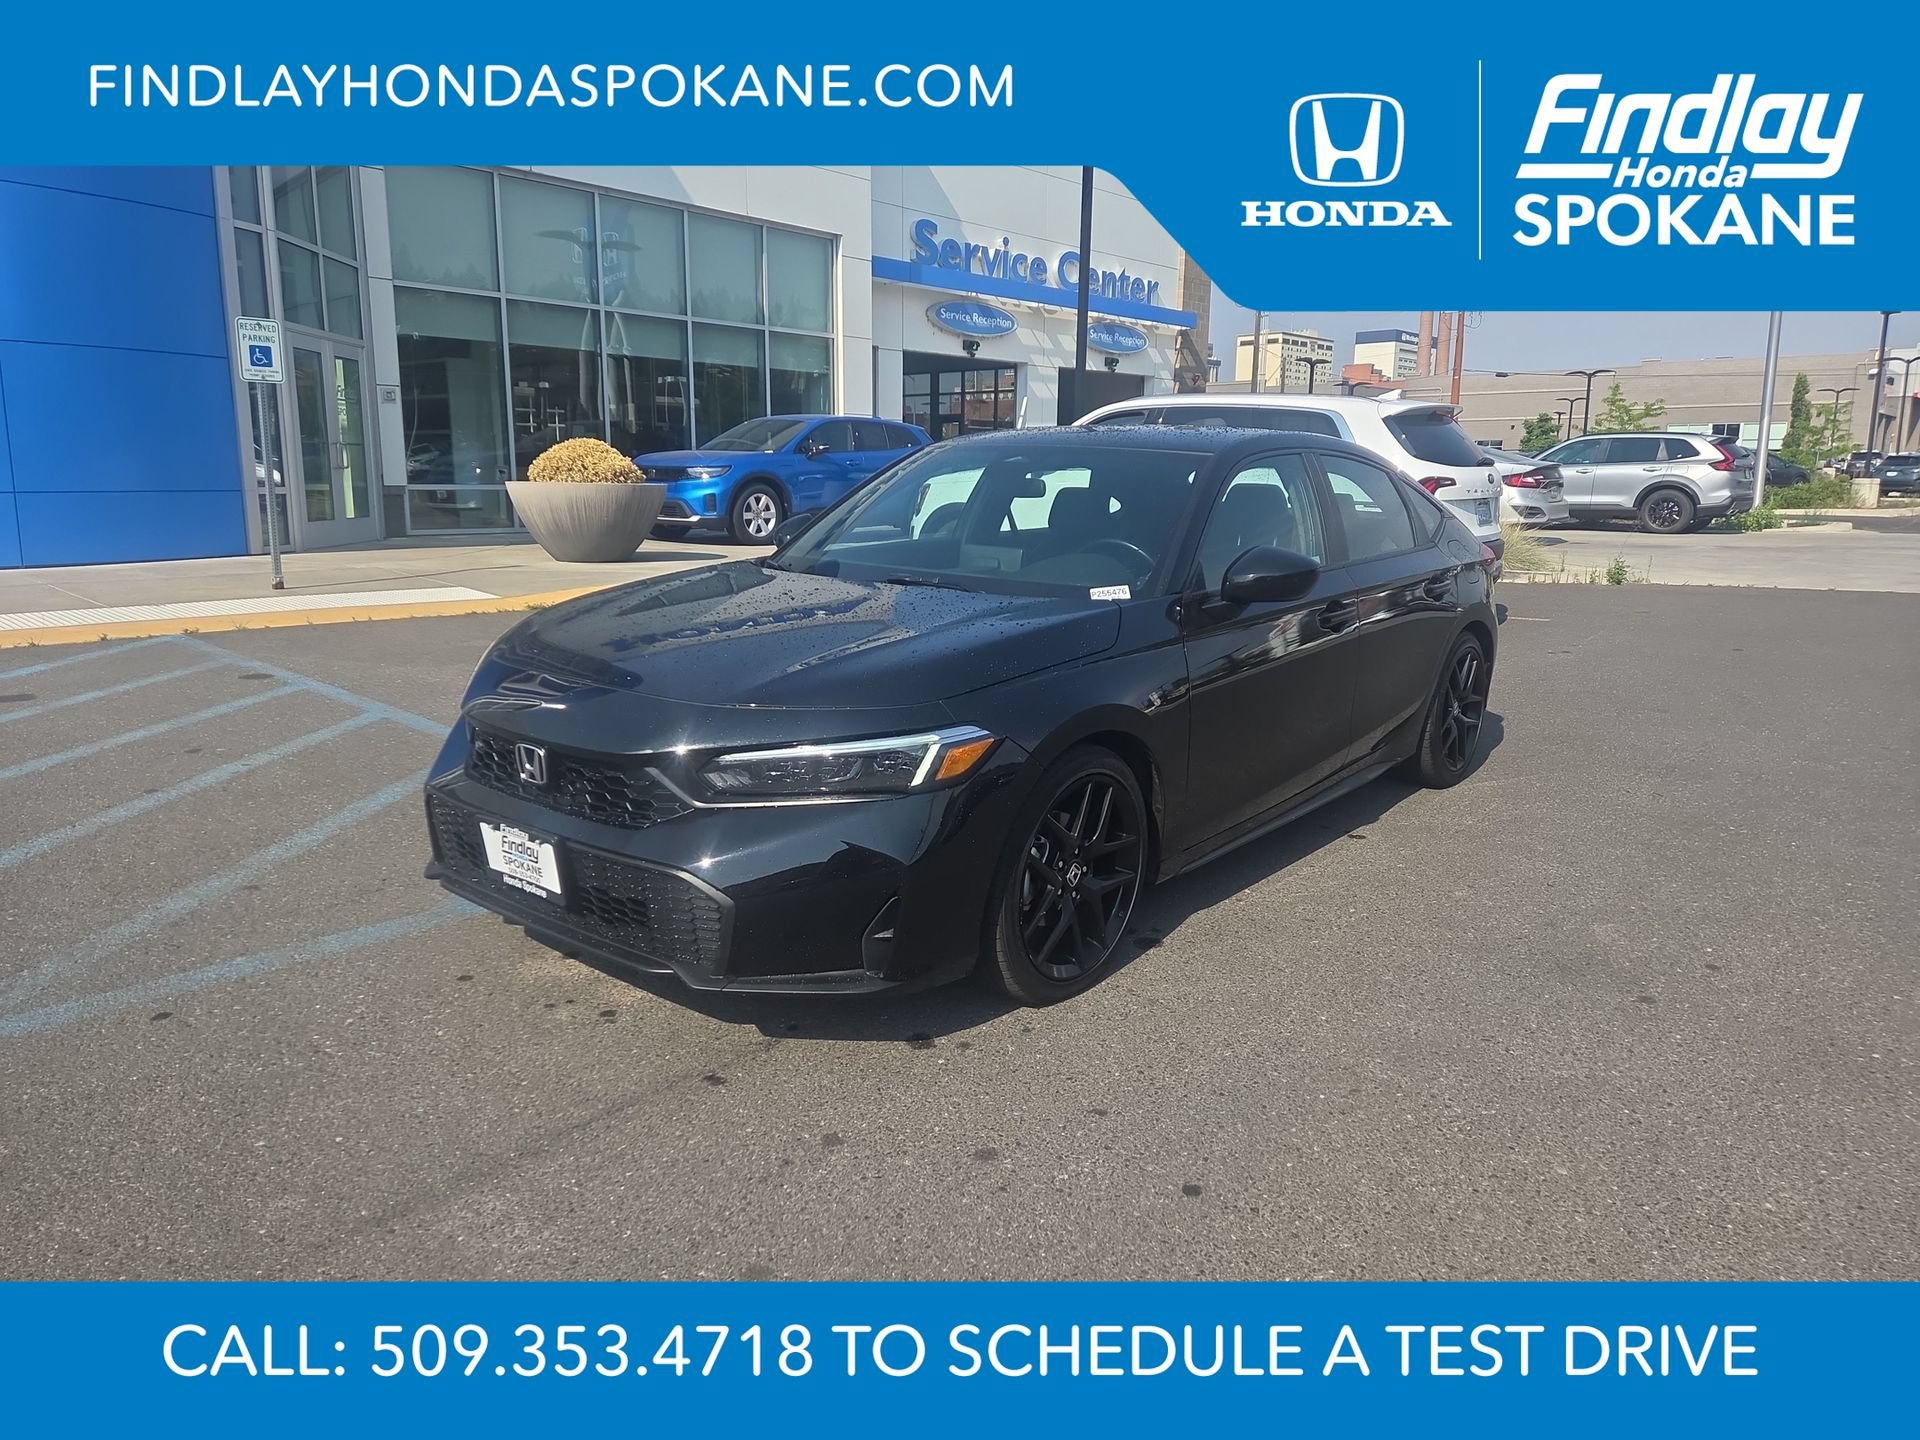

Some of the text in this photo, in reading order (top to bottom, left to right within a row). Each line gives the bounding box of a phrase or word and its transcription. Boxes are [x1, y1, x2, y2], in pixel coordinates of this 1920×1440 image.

[911, 218, 1160, 303] Service Center
[239, 322, 277, 333] RESERVED
[940, 307, 1012, 329] Service Reception
[242, 333, 276, 344] PARKING
[1089, 329, 1145, 346] Service Reception
[501, 834, 539, 863] Findlay
[503, 856, 543, 877] SPOKANE
